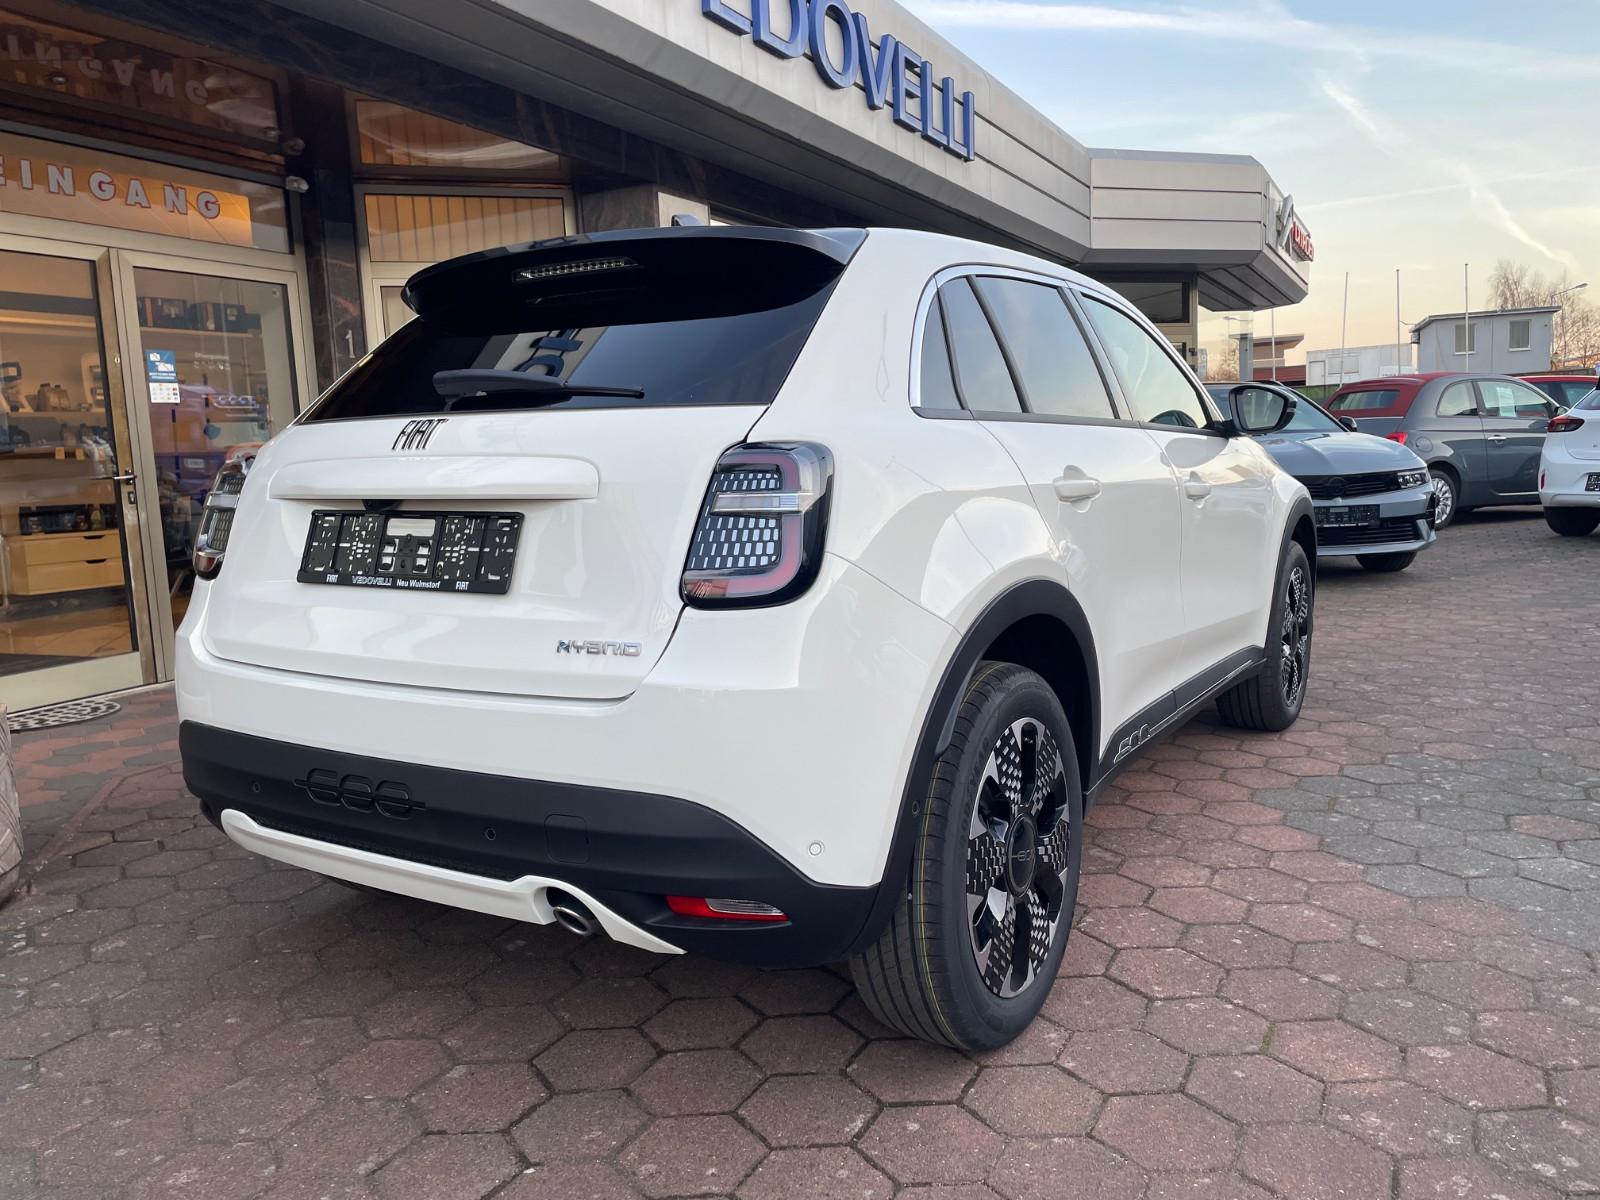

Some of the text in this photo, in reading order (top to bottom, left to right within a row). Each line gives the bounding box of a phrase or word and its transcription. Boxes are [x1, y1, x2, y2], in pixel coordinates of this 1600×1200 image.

[702, 0, 975, 162] DOVELLI
[391, 418, 449, 450] FIAT
[326, 574, 339, 583] FIAT
[455, 581, 470, 591] FIAT
[556, 639, 641, 657] HYBRID
